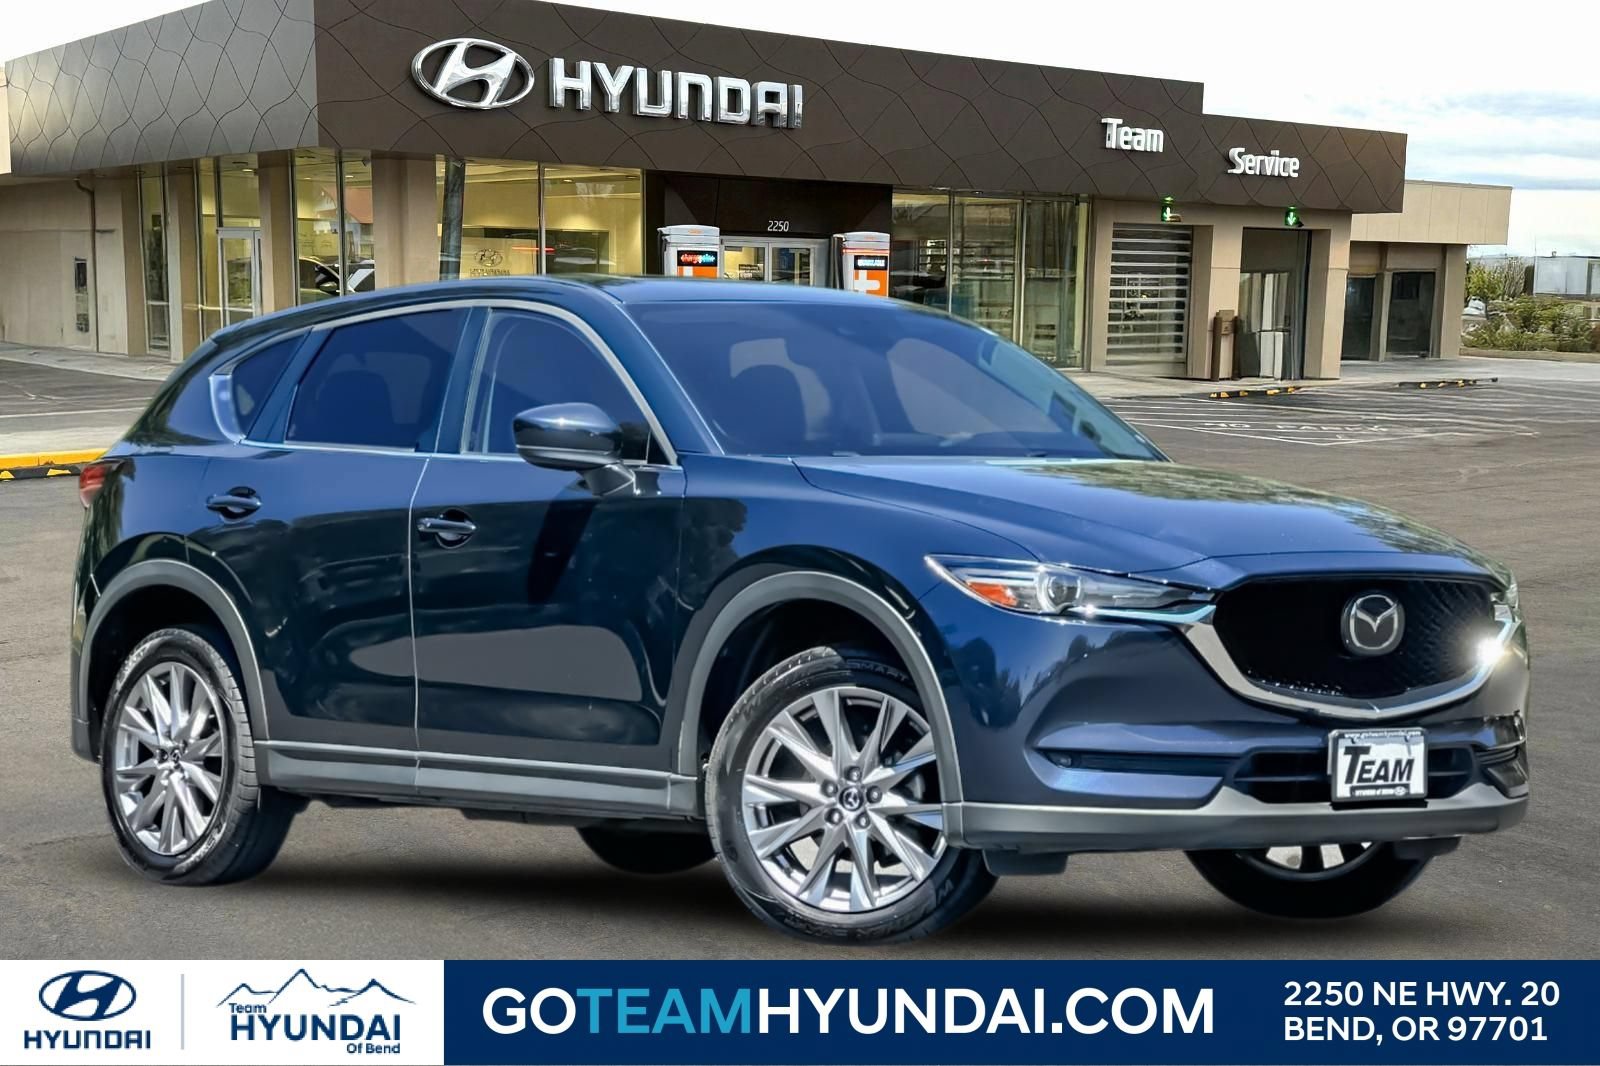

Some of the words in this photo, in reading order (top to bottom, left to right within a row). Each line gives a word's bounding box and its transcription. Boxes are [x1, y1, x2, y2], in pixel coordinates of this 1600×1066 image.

[549, 57, 803, 129] HYUNDAI
[1101, 117, 1165, 153] Team
[1227, 147, 1300, 178] Service
[767, 220, 790, 232] 2250
[1343, 745, 1415, 785] TEAM
